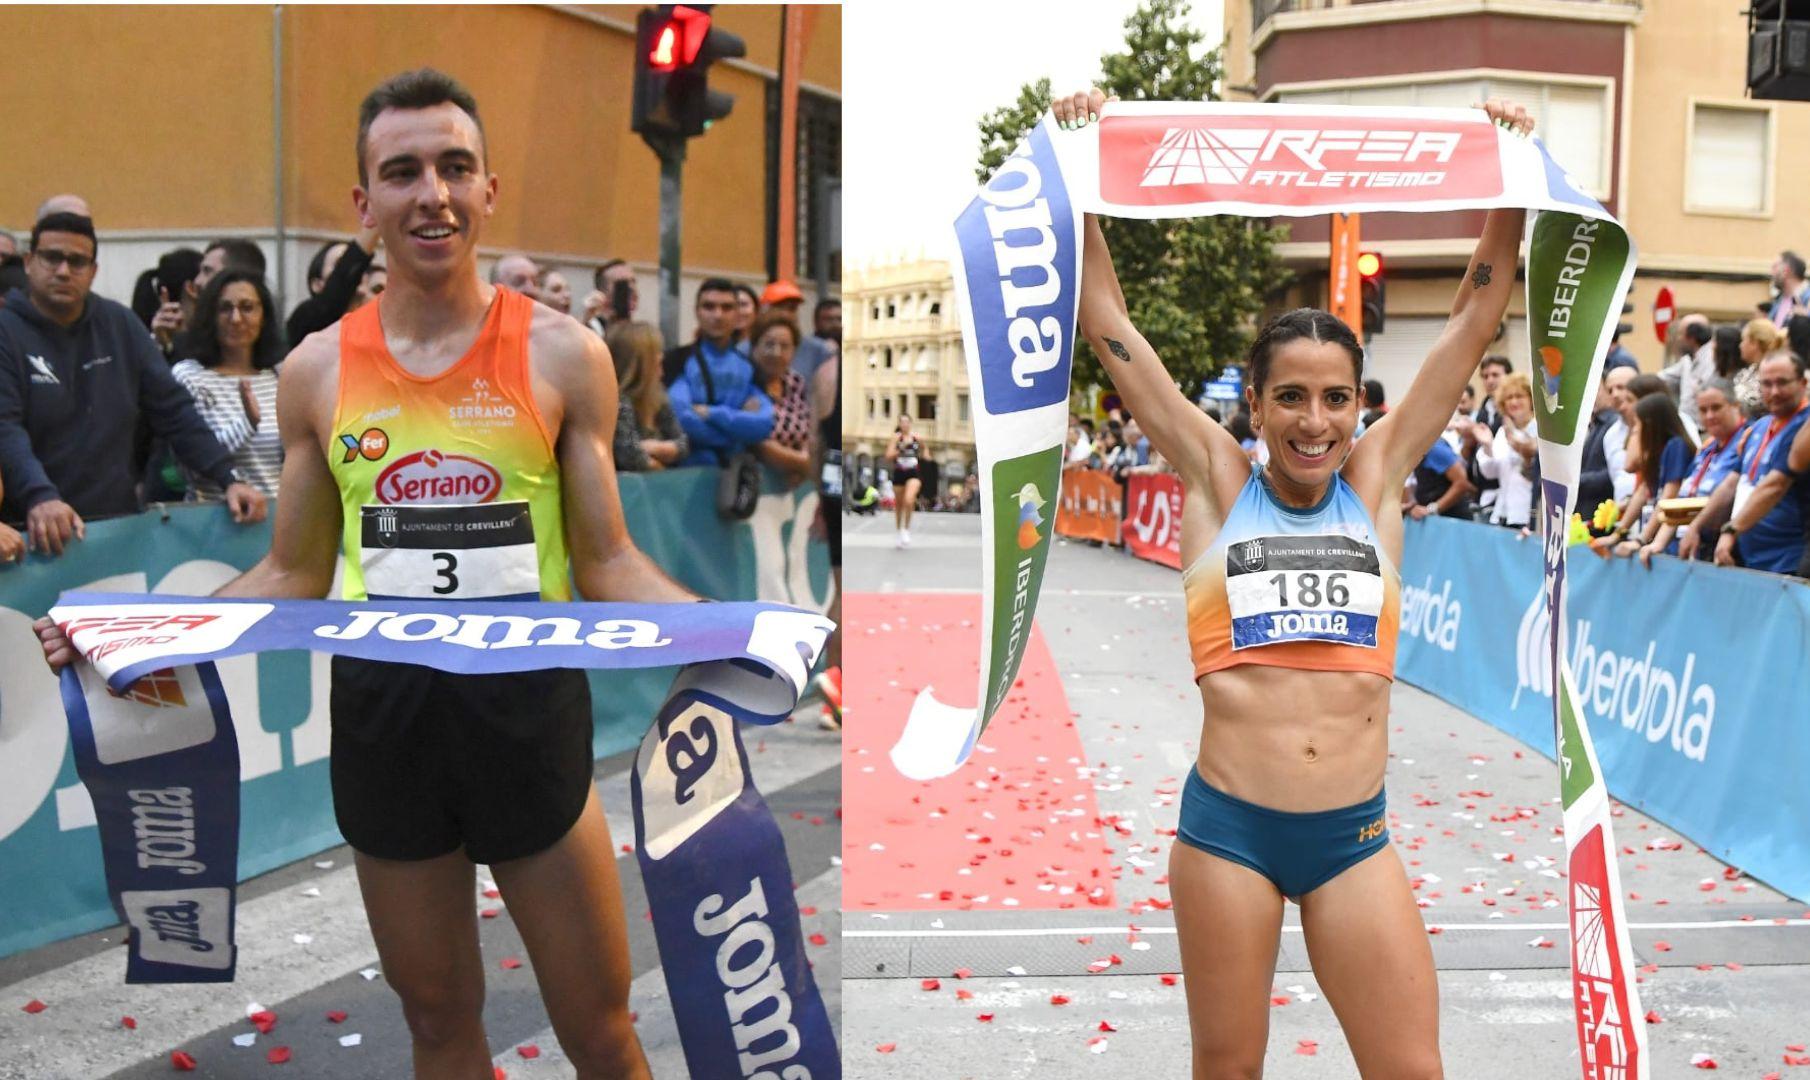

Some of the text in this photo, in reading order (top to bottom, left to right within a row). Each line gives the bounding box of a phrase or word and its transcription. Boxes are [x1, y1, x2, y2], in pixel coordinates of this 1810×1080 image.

[1259, 128, 1463, 171] RFEA
[1249, 170, 1447, 188] ATLETISMO
[977, 142, 1063, 388] oma
[448, 405, 516, 418] SERRANO
[362, 437, 386, 451] Fer
[388, 473, 491, 504] Serrano
[401, 519, 516, 533] AJUNTAMENT DE CREVILLENT
[1267, 548, 1315, 556] AJUNTAMENT
[1316, 548, 1327, 556] DE
[432, 551, 460, 595] 3
[1269, 572, 1350, 608] 186
[57, 614, 223, 639] FEA
[1266, 612, 1349, 639] Joma
[1401, 574, 1461, 652] erdrola
[313, 610, 673, 650] Joma
[1572, 619, 1716, 762] Iberdrola
[127, 786, 207, 875] Joma
